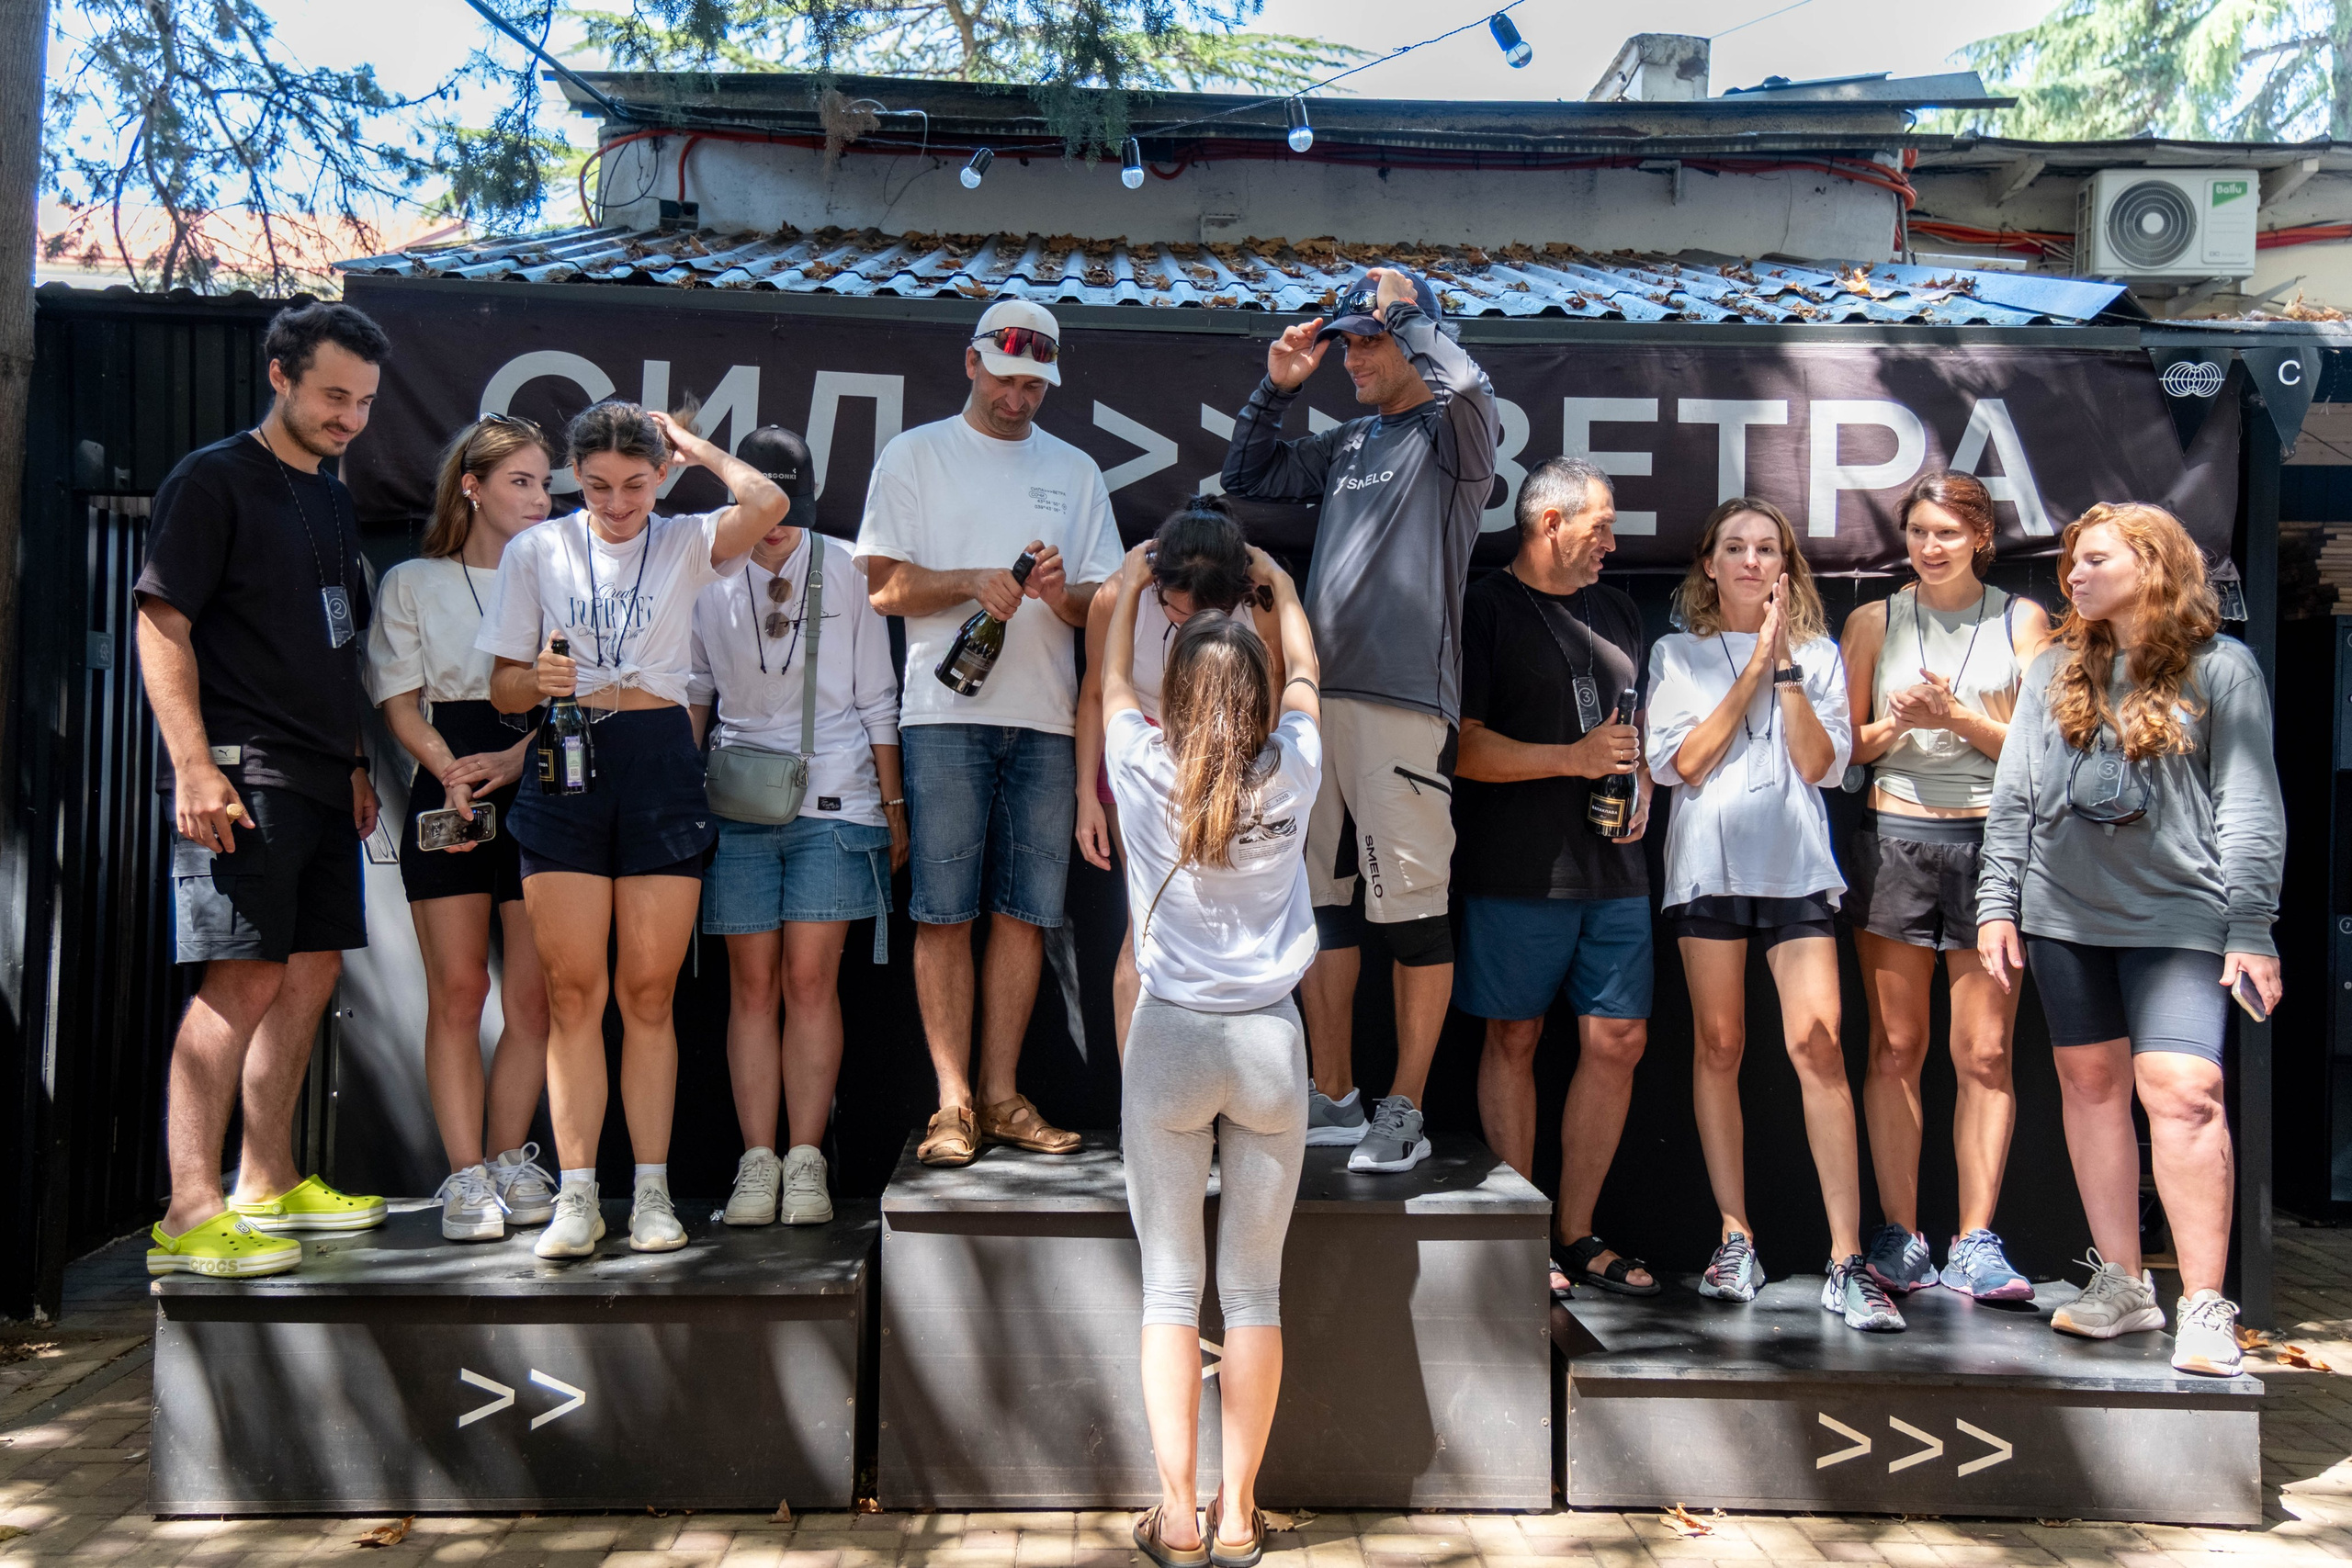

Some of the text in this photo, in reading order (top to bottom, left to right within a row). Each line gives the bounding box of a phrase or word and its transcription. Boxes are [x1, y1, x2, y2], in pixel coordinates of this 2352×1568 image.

[2215, 183, 2243, 195] Ballu
[478, 349, 2054, 538] СИЛ ВЕТРА
[762, 472, 797, 480] OSGONKI
[334, 602, 343, 615] 2
[1582, 691, 1591, 703] 3
[2102, 762, 2115, 775] 3
[1364, 834, 1384, 898] SMELO
[189, 1258, 239, 1273] crocs
